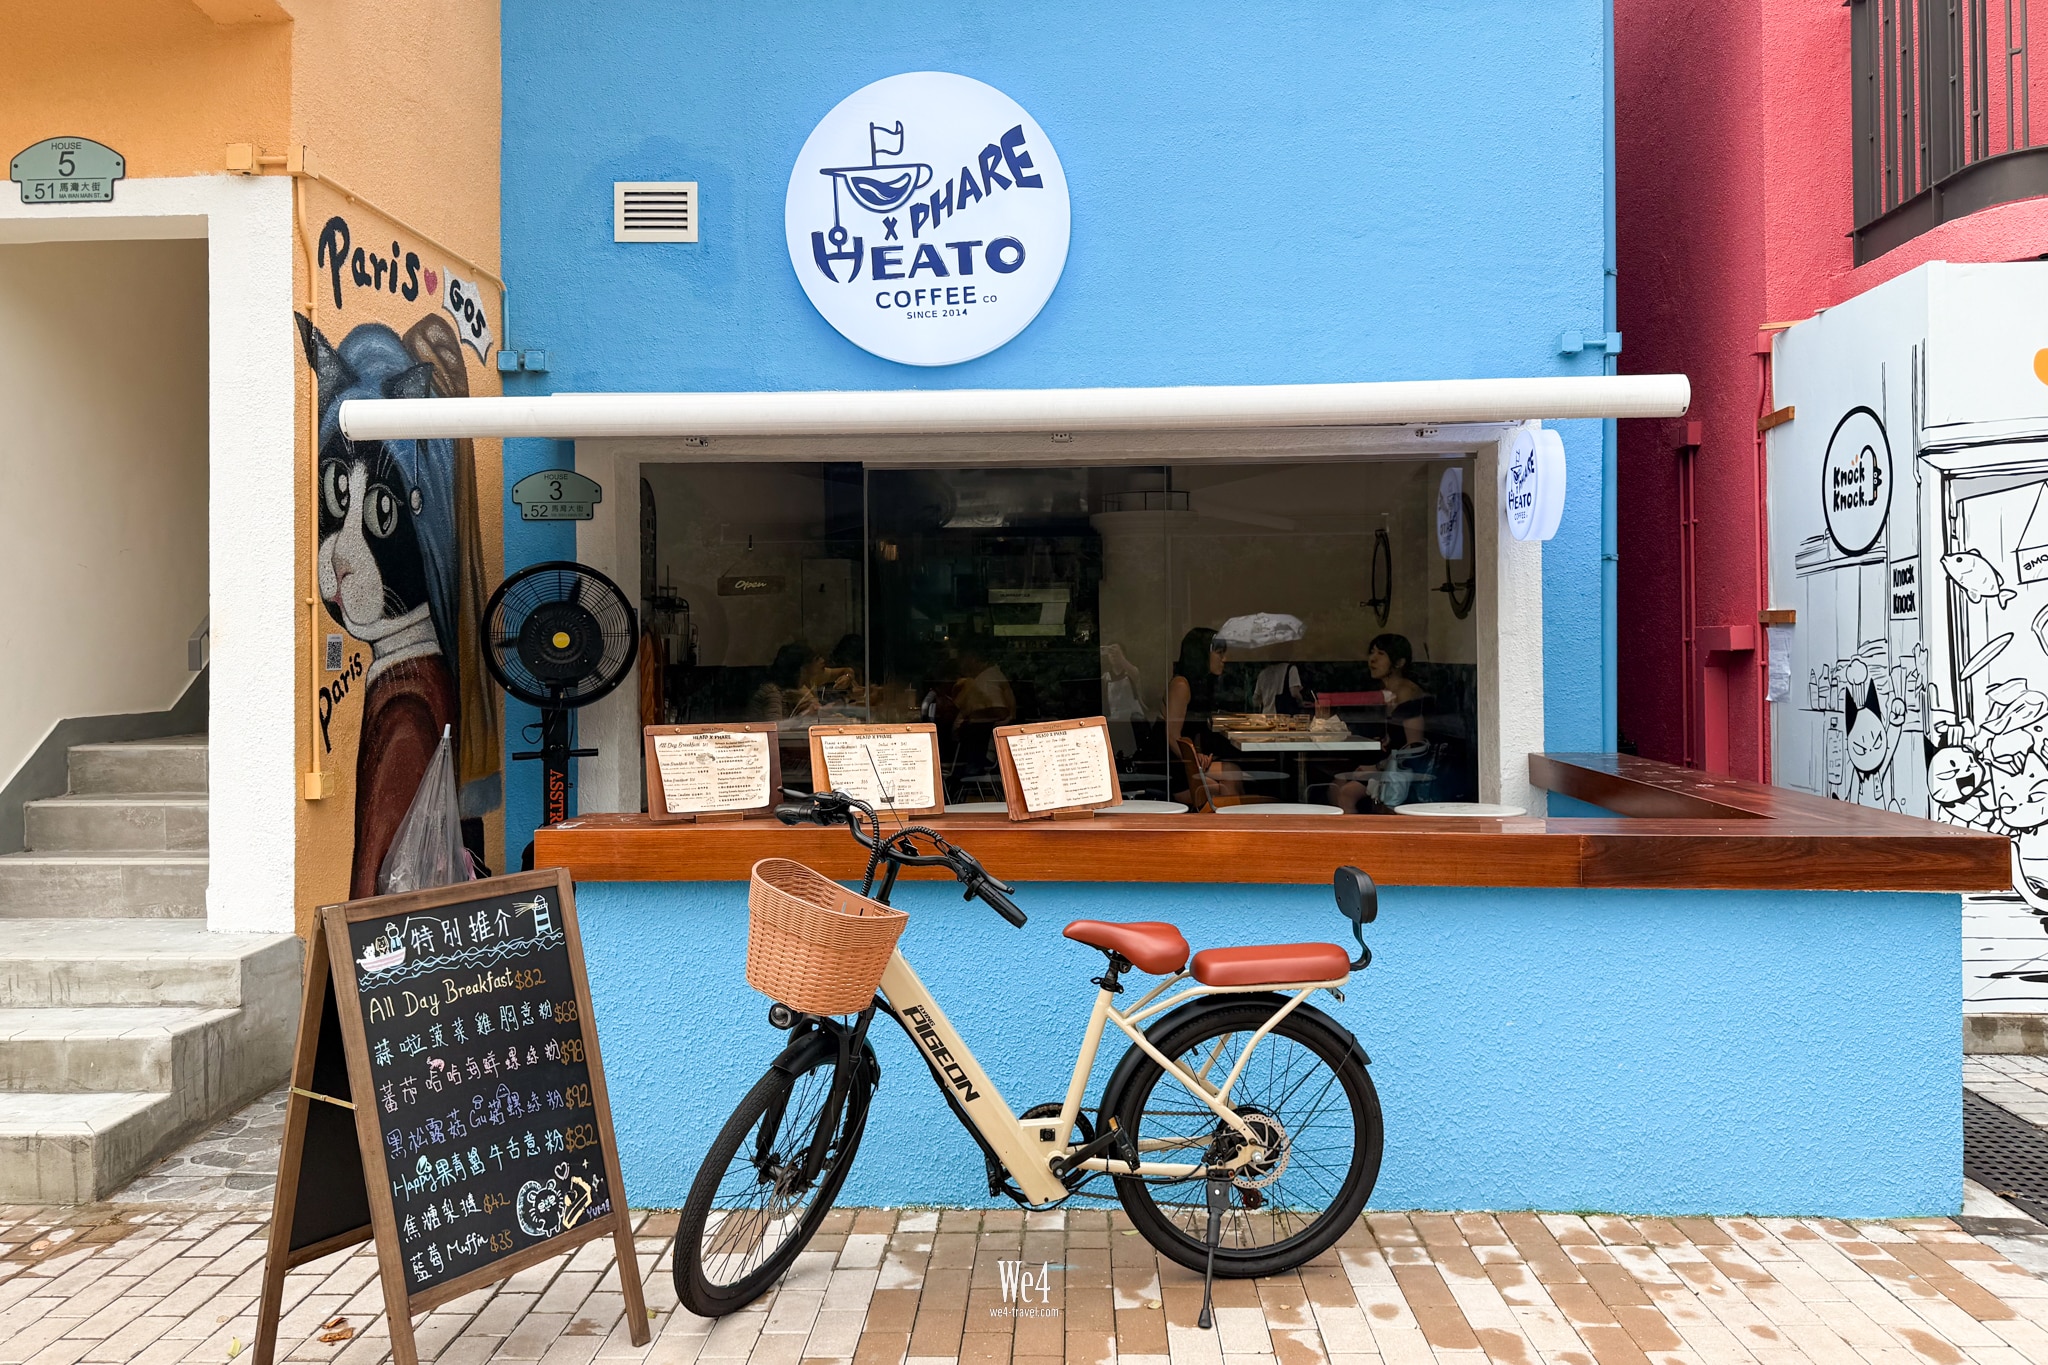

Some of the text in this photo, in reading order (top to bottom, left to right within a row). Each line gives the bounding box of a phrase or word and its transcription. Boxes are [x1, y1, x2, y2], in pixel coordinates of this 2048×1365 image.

[51, 142, 82, 150] HOUSE
[58, 151, 76, 177] 5
[34, 182, 101, 200] 51 馬灣大街
[909, 124, 1044, 239] PHARE
[318, 216, 420, 309] Paris
[810, 230, 1026, 284] HEATO
[875, 285, 998, 309] COFFEE CO
[906, 308, 968, 320] SINCE 2014
[1833, 461, 1865, 489] Knock
[549, 480, 563, 501] 3
[1508, 491, 1532, 511] HEATO
[530, 504, 549, 518] 52
[734, 580, 768, 590] Open
[318, 652, 363, 755] Paris
[410, 908, 512, 955] 特別推介
[369, 967, 547, 1024] All Day Breakfast $82
[554, 1000, 578, 1025] $68
[917, 1004, 936, 1027] FLYING
[560, 1038, 585, 1066] $98
[902, 1006, 981, 1103] PIGEON
[565, 1082, 592, 1110] $92
[566, 1123, 598, 1152] $82
[403, 1192, 511, 1244] 焦糖梨撻 $42
[446, 1231, 490, 1262] Muffin
[489, 1229, 514, 1254] $35
